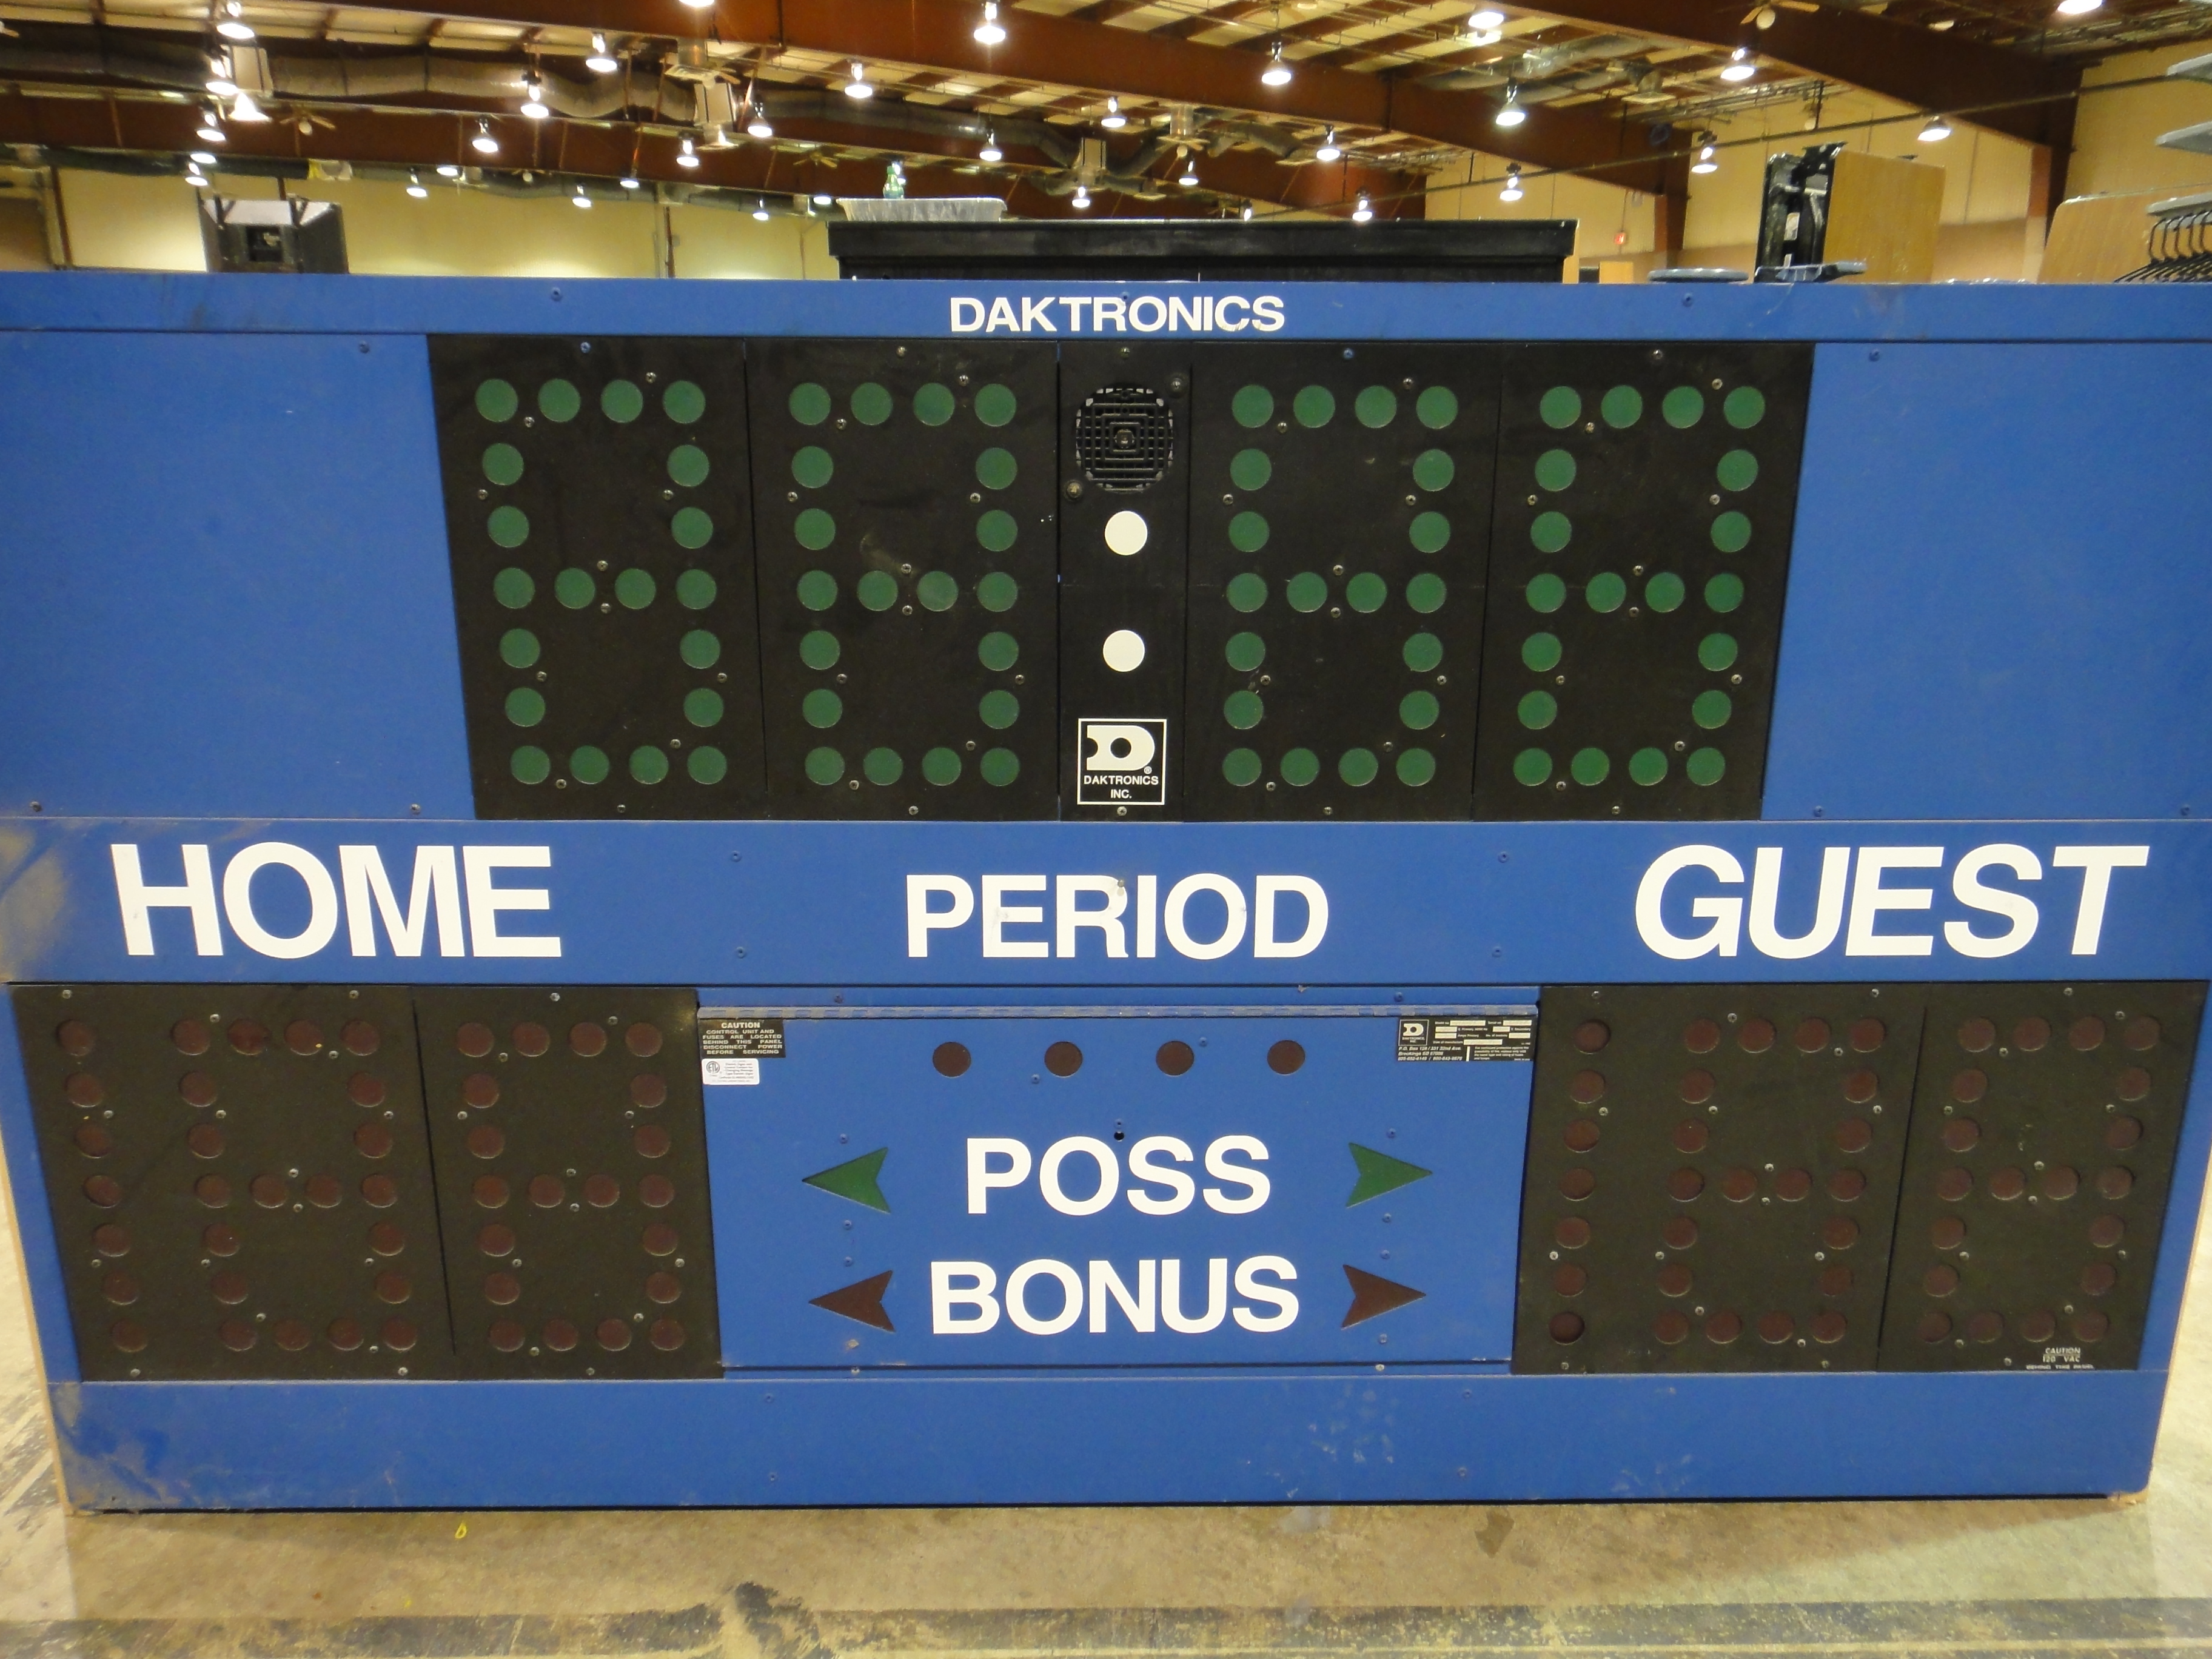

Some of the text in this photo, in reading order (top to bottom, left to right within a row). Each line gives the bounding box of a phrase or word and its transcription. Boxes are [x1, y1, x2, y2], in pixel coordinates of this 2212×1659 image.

[950, 295, 1285, 333] DAKTRONICS
[1084, 775, 1159, 785] DAKTRONICS
[1110, 789, 1132, 799] INC.
[110, 841, 562, 959] HOME
[906, 873, 1329, 960] PERIOD
[1635, 843, 2150, 960] GUEST
[967, 1134, 1271, 1216] POSS
[931, 1255, 1299, 1335] BONUS
